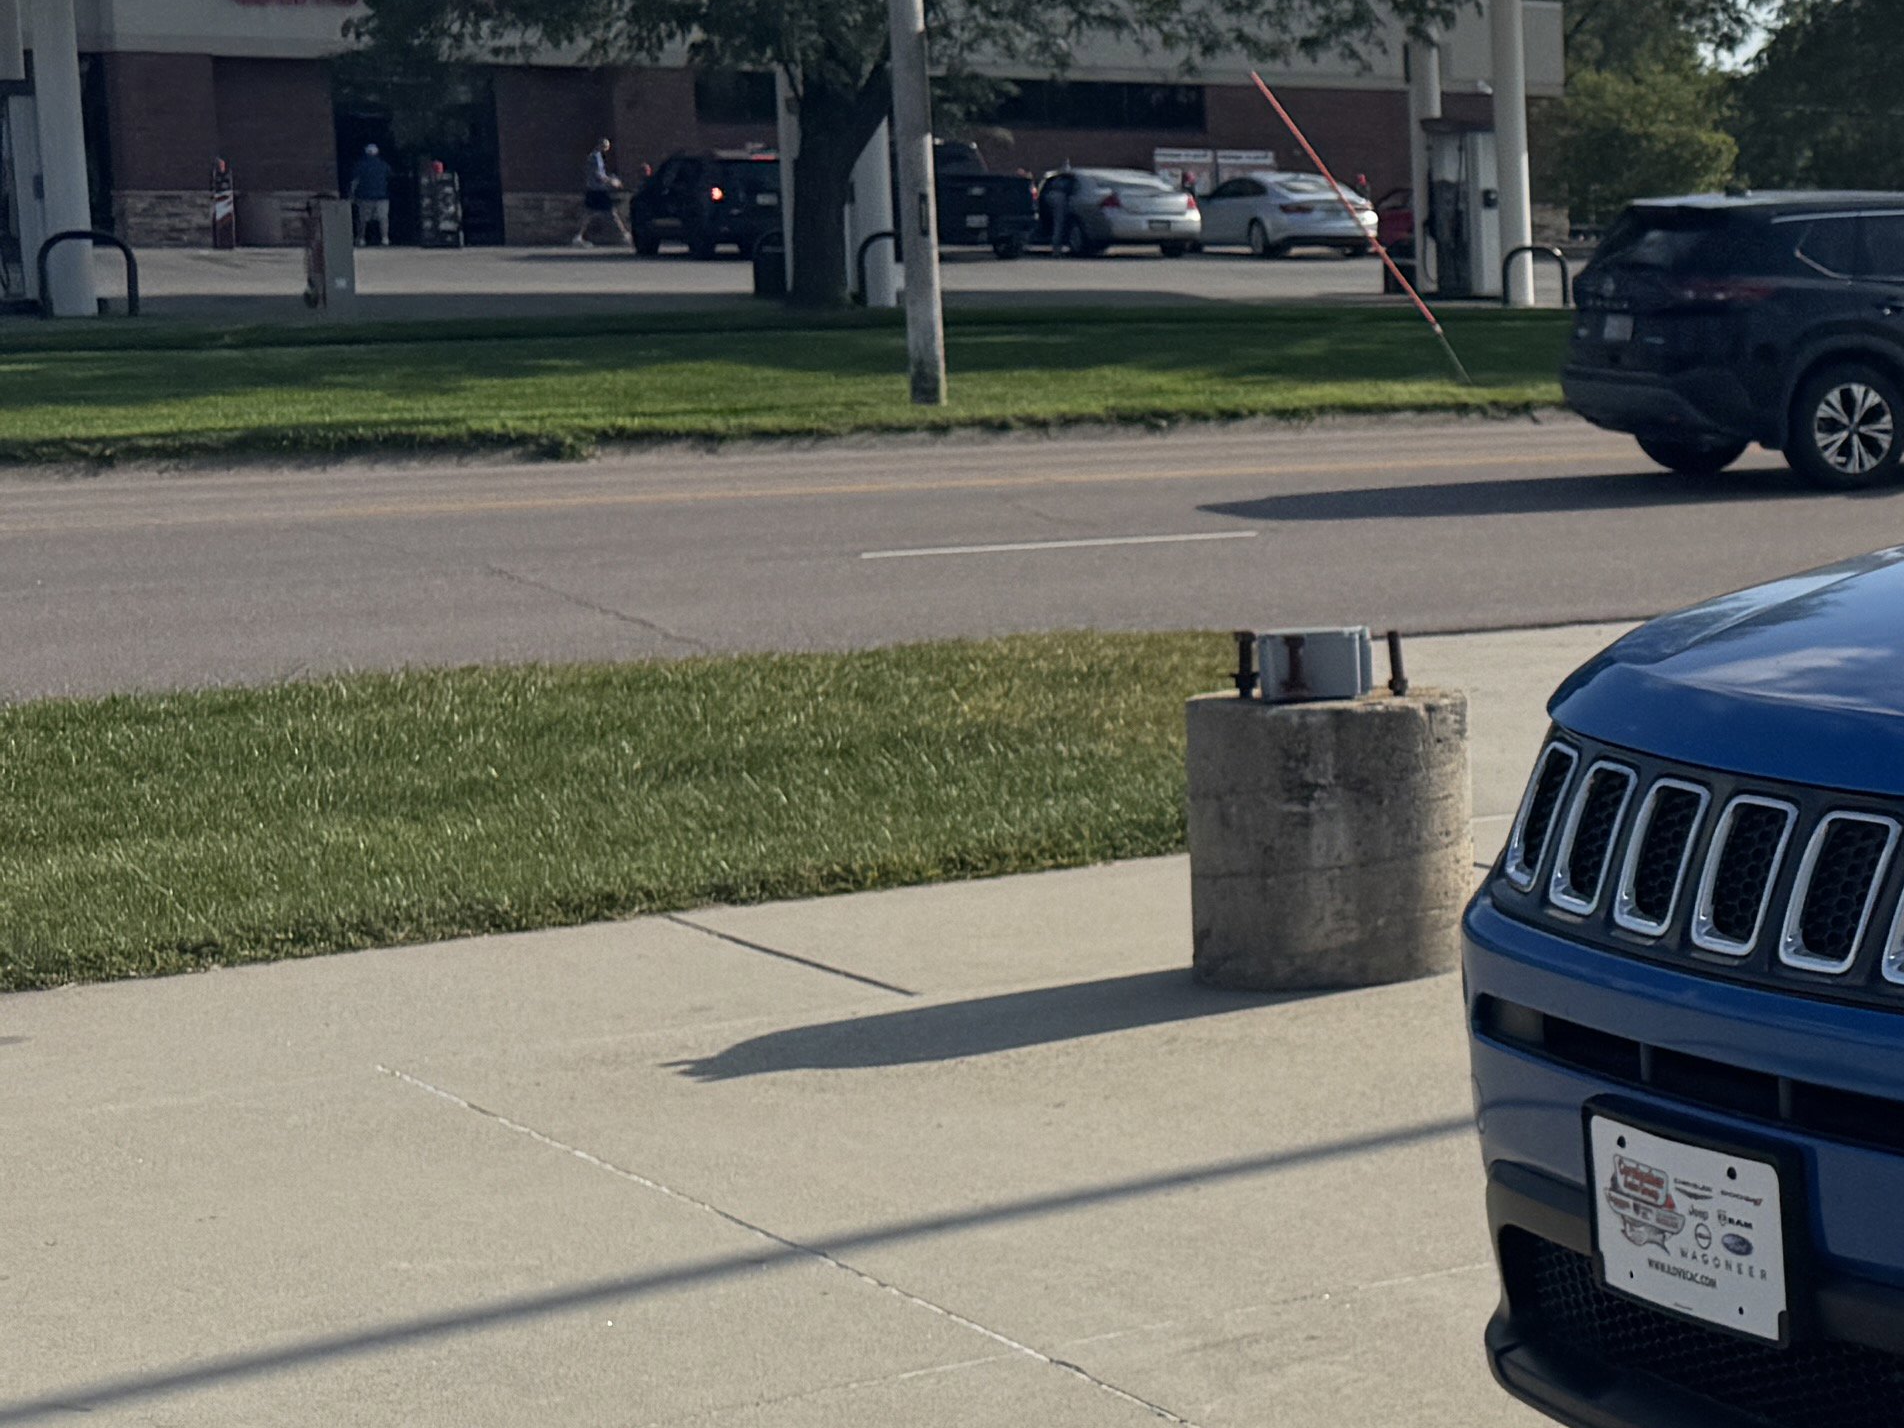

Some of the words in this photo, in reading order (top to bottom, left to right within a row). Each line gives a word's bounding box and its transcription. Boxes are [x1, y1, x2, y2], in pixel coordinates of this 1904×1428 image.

[1688, 1204, 1709, 1222] Jeep
[1728, 1216, 1754, 1230] RAM
[1679, 1247, 1768, 1282] WAGONEER
